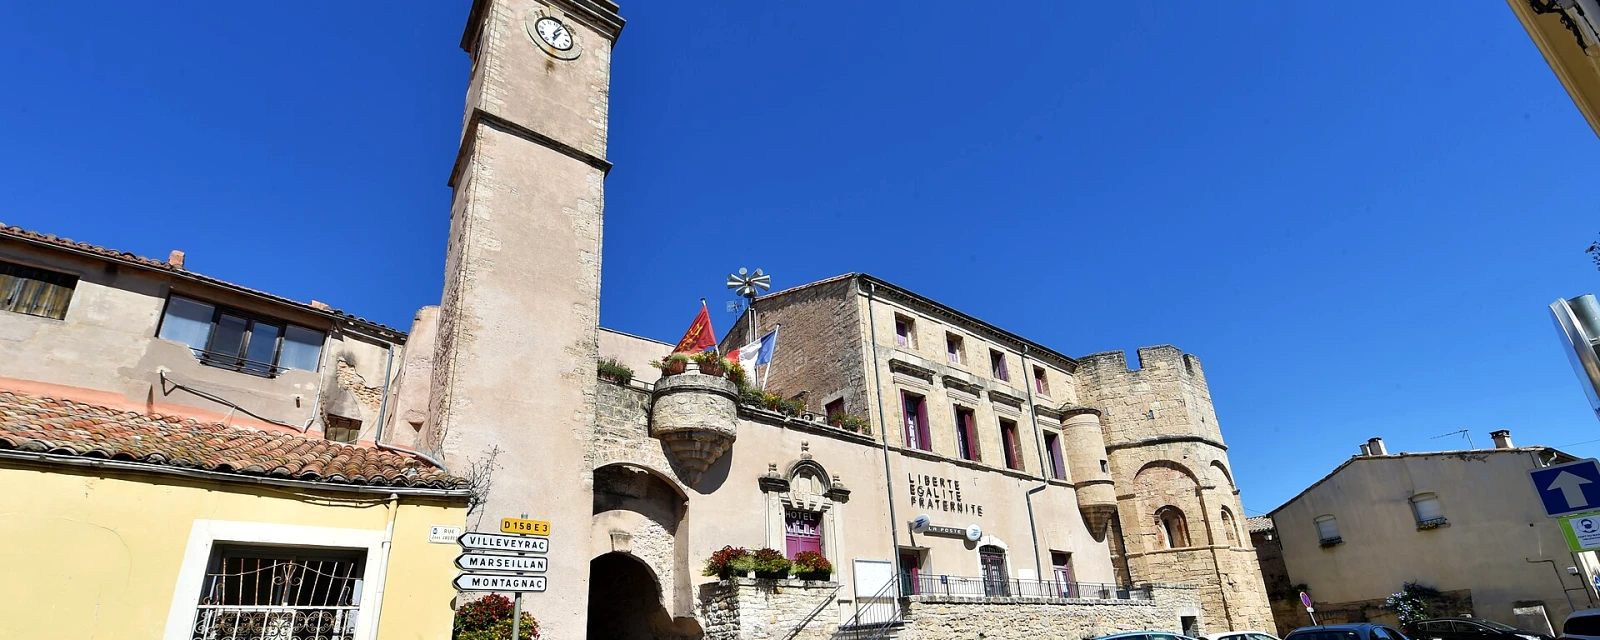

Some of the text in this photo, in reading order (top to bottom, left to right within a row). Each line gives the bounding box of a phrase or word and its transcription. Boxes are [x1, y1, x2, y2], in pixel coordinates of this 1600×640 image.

[908, 472, 960, 491] LIBERTE
[909, 484, 962, 502] EGALITE
[911, 496, 983, 517] FRATERNITE
[785, 522, 816, 535] VILLE
[469, 536, 545, 549] VILLEVEYRAC
[469, 557, 544, 569] MARSEILLAN
[471, 577, 543, 588] MONTAGNAC
